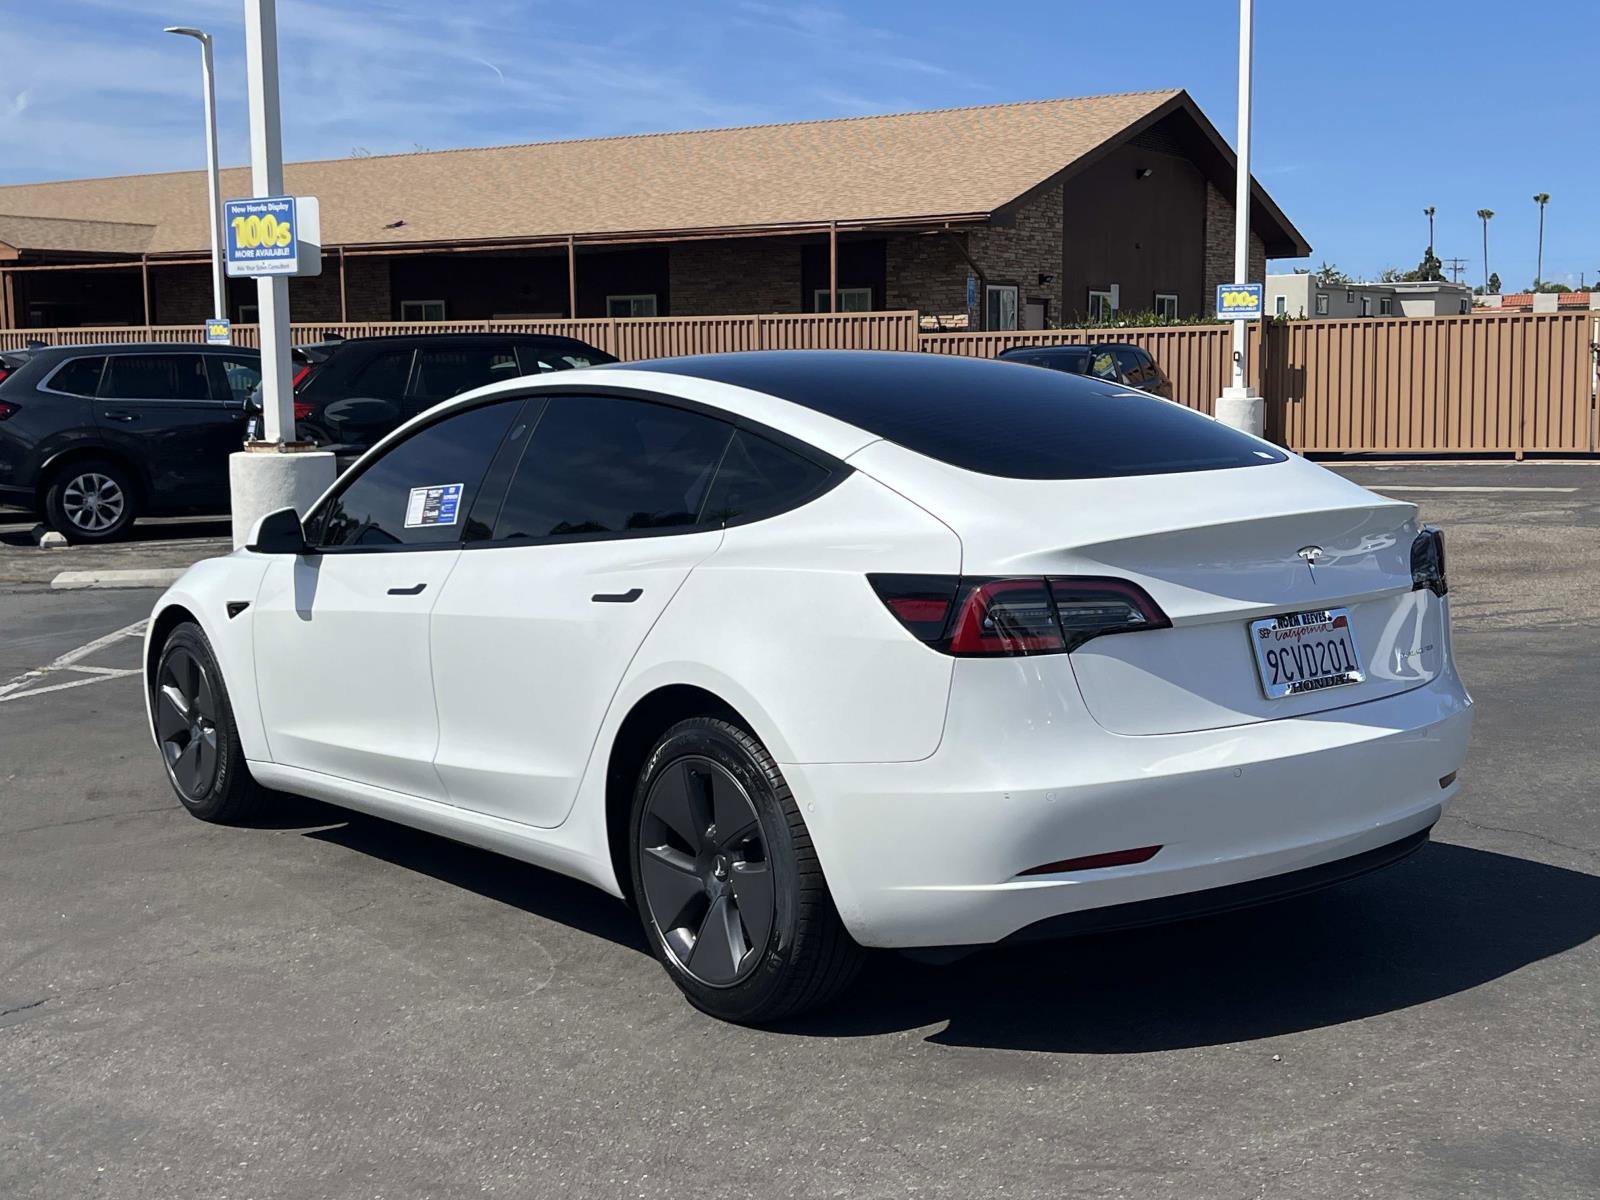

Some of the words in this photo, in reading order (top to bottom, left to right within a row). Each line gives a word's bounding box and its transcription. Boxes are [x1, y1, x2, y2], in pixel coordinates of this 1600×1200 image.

[231, 206, 246, 214] New
[268, 203, 289, 212] Display
[231, 214, 291, 248] 100s
[235, 250, 254, 258] MORE
[256, 248, 290, 257] AVAILABLE!
[1221, 291, 1258, 307] 100s
[1301, 611, 1327, 625] REEVES
[1259, 628, 1271, 639] SEP
[1275, 623, 1328, 642] California
[1266, 637, 1356, 685] 9CVD201
[1289, 673, 1347, 694] HONDA
